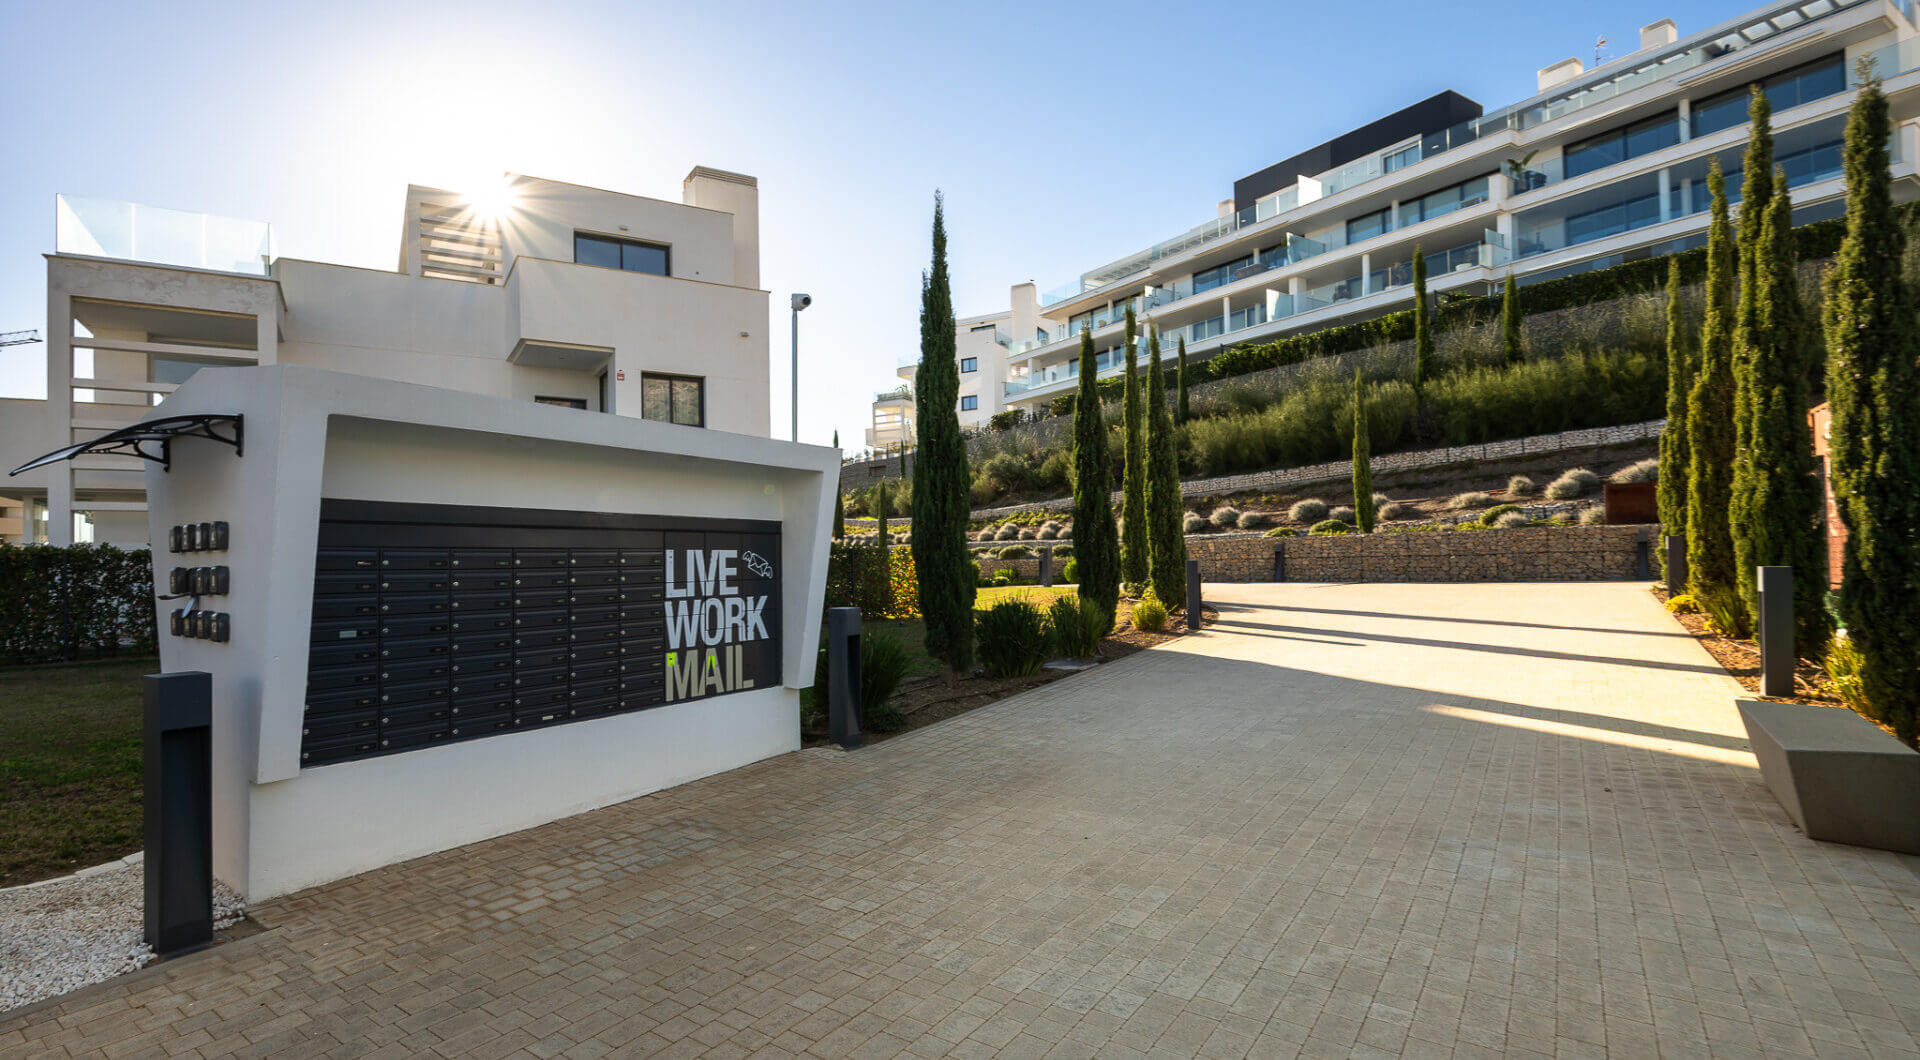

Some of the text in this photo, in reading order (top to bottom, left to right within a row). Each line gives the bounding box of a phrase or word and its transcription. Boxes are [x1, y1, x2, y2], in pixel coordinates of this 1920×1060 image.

[665, 549, 738, 598] LIVE
[664, 595, 769, 649] WORK
[665, 644, 754, 701] MAIL
